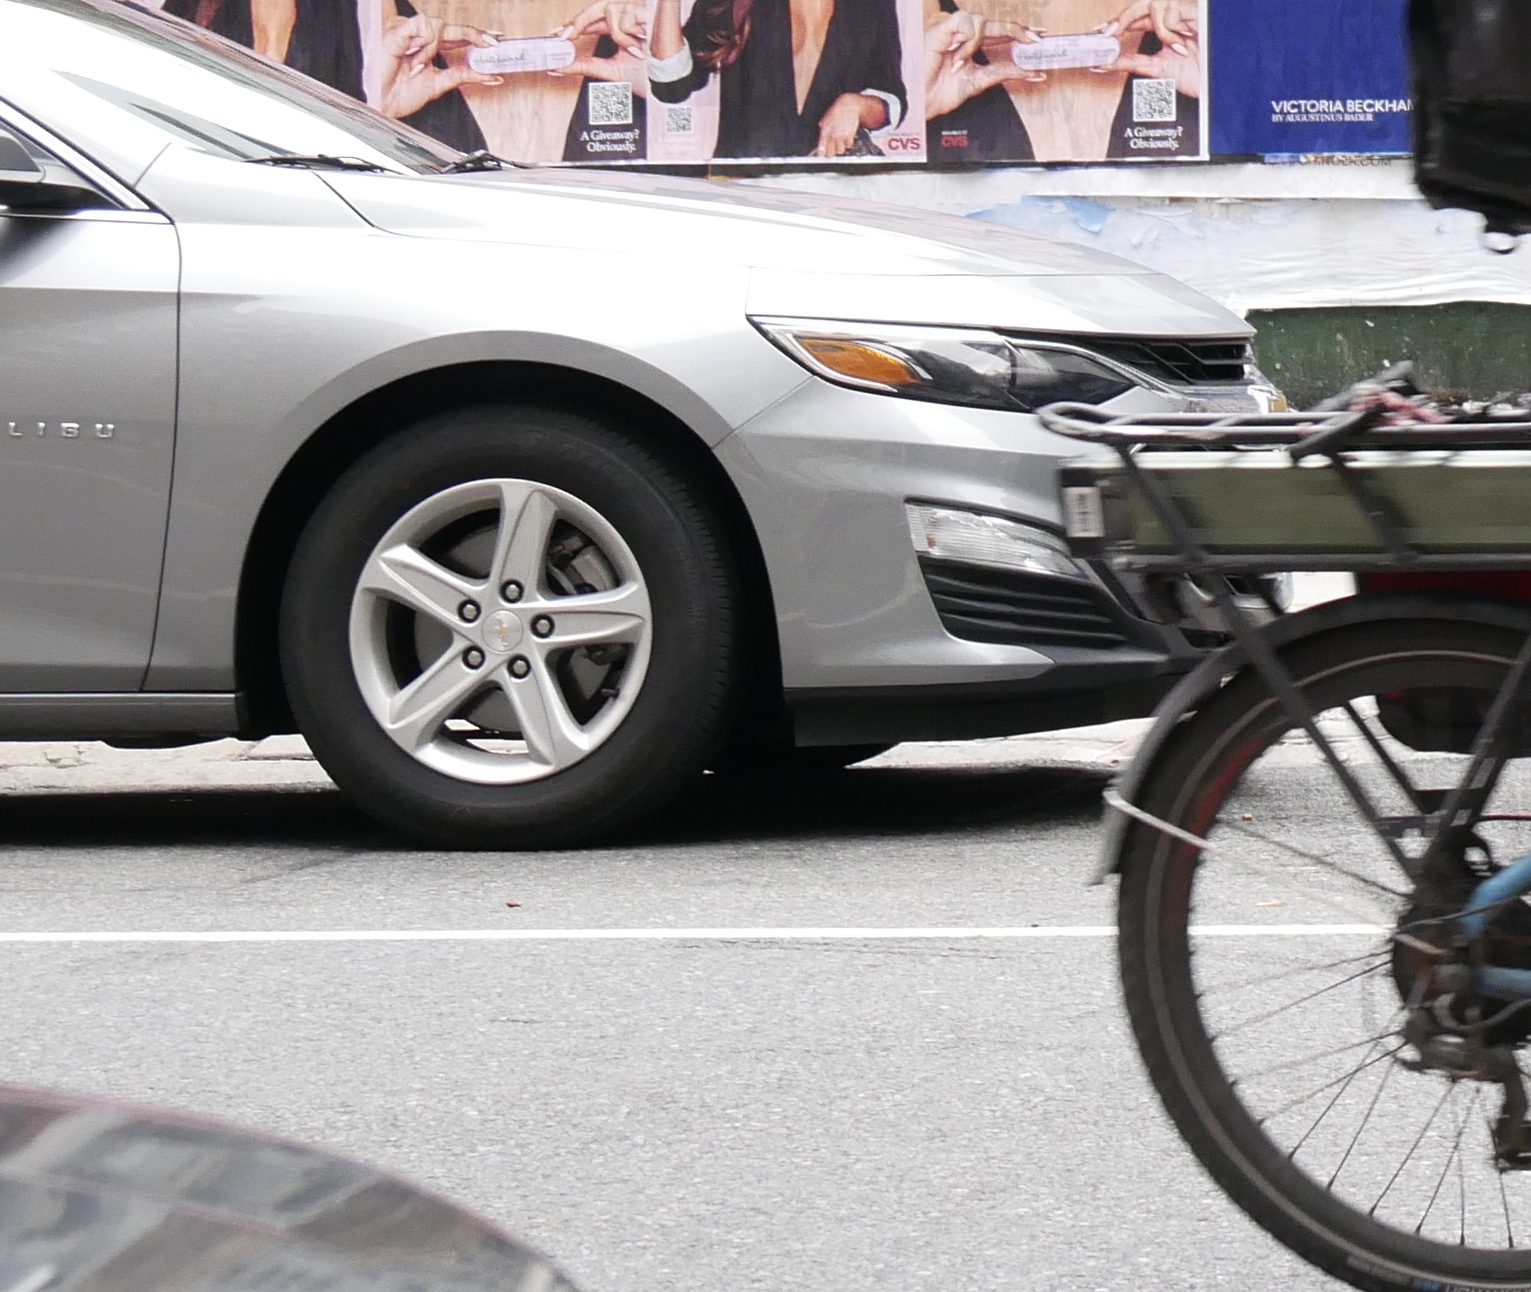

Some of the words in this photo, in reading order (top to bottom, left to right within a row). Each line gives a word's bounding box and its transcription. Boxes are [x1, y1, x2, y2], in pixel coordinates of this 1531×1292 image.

[1271, 100, 1344, 113] VICTORIA
[1272, 113, 1284, 122] BY
[1344, 113, 1373, 122] BADER
[888, 138, 920, 151] CVS
[8, 421, 115, 438] LIBU
